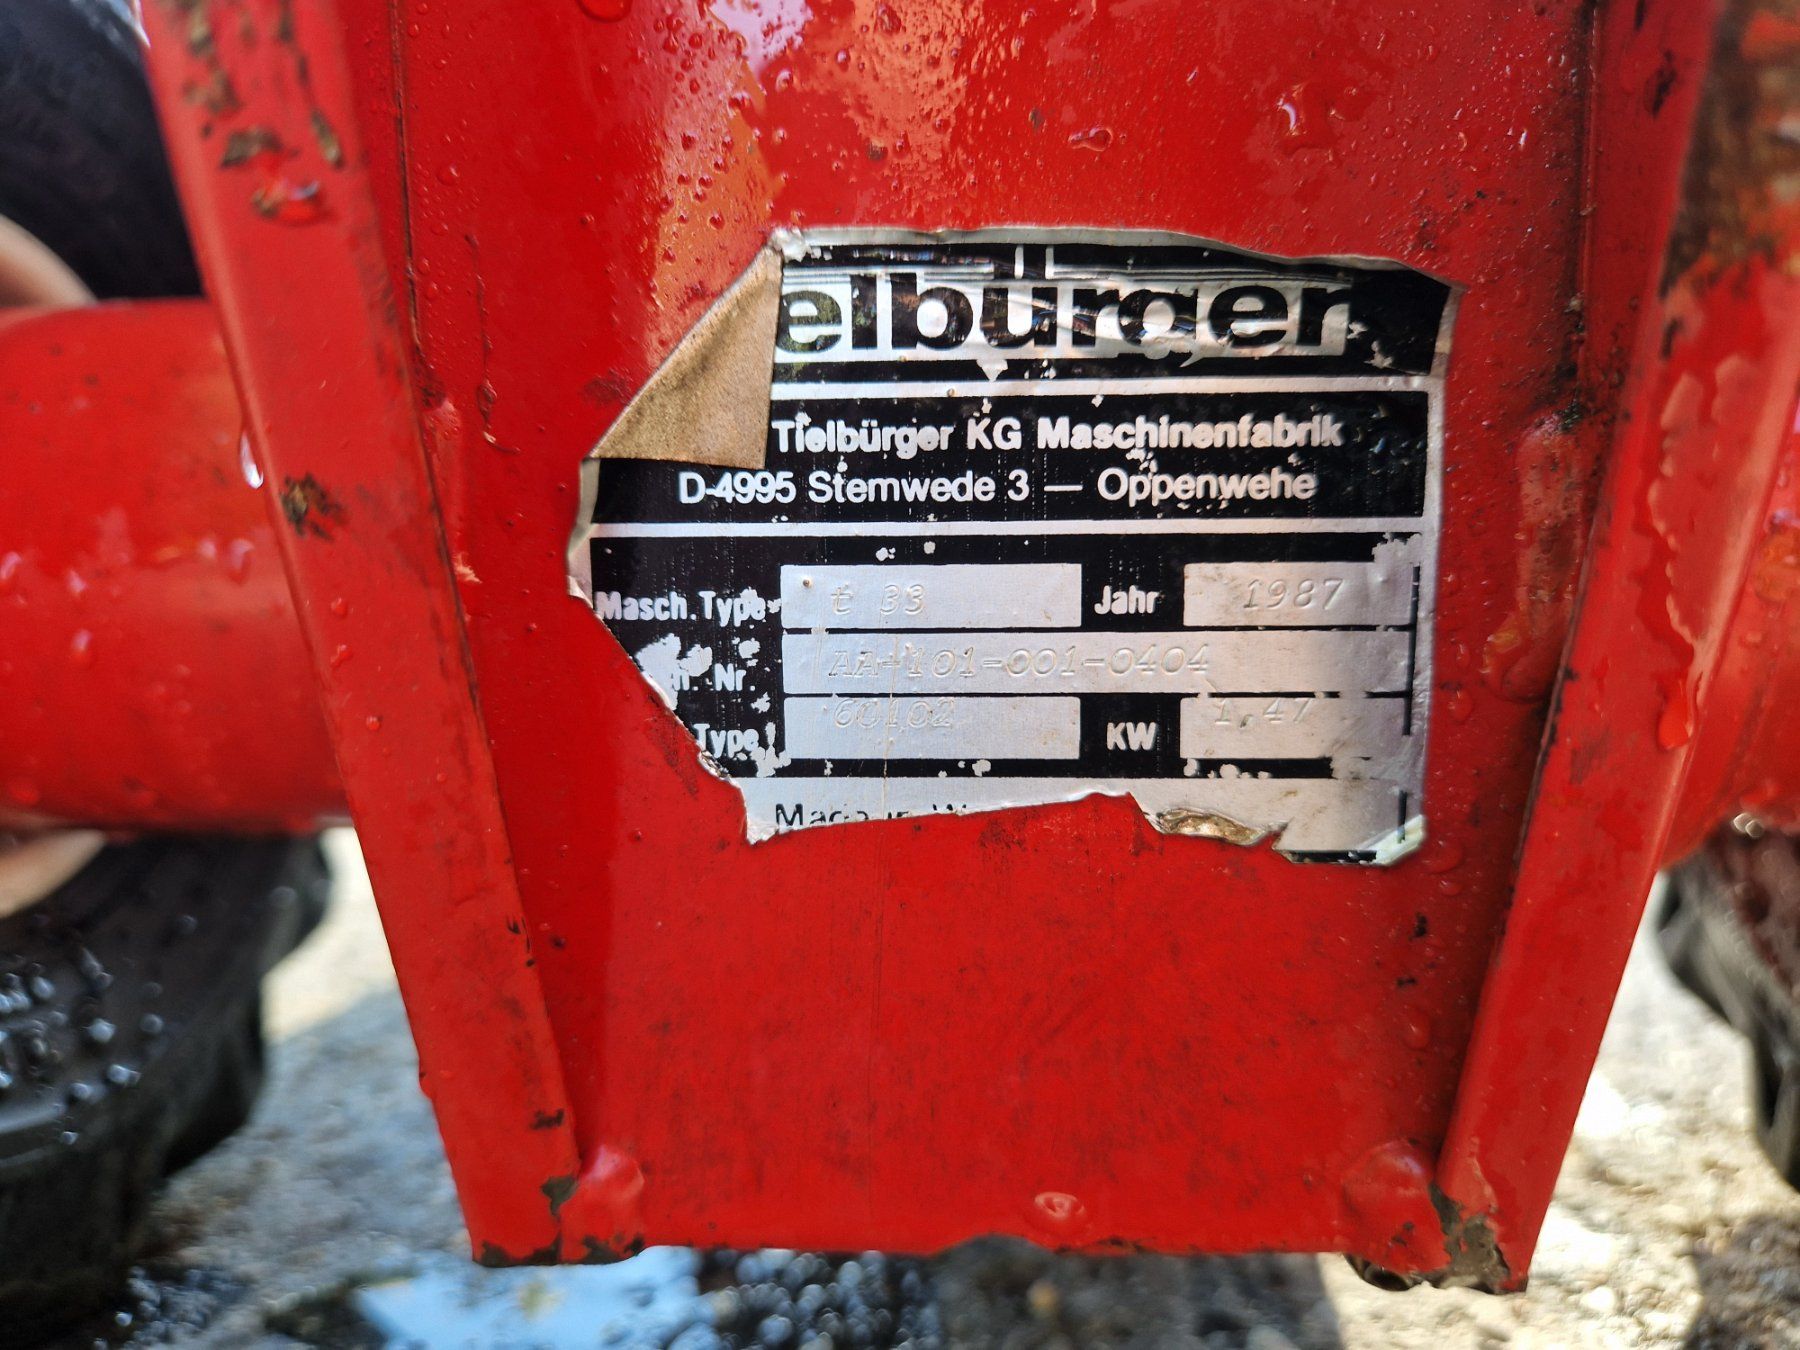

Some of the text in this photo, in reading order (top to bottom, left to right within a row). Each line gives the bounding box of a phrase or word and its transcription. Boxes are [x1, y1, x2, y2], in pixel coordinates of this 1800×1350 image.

[771, 413, 1345, 458] Tielbürger KG Maschinenfabrik
[679, 470, 797, 504] D-4995
[808, 469, 996, 503] Stemwede
[1007, 469, 1030, 502] 3
[1097, 466, 1317, 507] Oppenwehe
[880, 583, 927, 616] 33
[1094, 585, 1162, 616] Jahr
[1242, 578, 1345, 610] 1987
[714, 663, 756, 692] Nr.
[832, 696, 957, 729] 60102
[1213, 697, 1313, 730] 1,47
[692, 723, 761, 759] Type
[1106, 721, 1158, 751] KW
